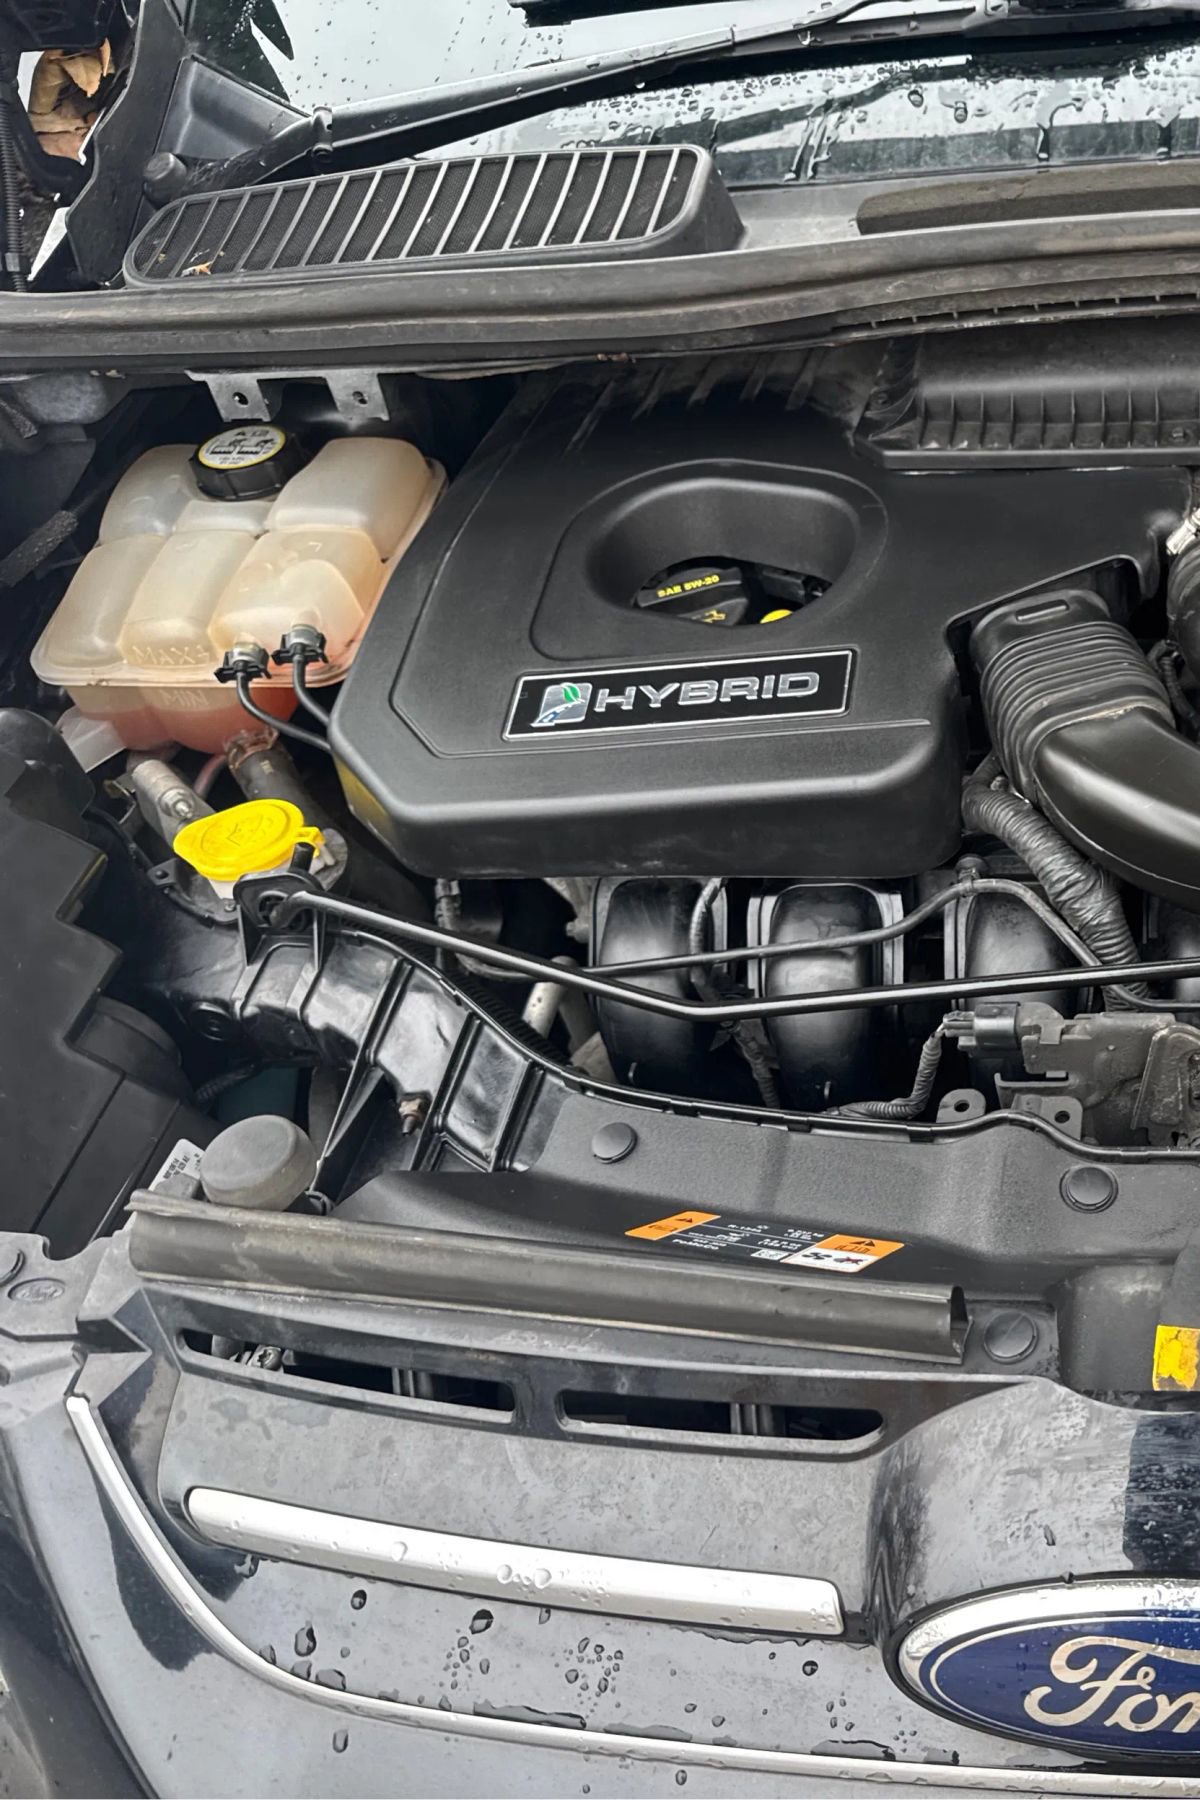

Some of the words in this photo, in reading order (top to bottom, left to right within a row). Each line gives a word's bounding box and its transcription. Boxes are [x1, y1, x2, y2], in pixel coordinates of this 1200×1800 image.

[657, 585, 682, 598] SAE
[683, 574, 720, 591] 5W-20
[594, 672, 821, 712] HYBRID
